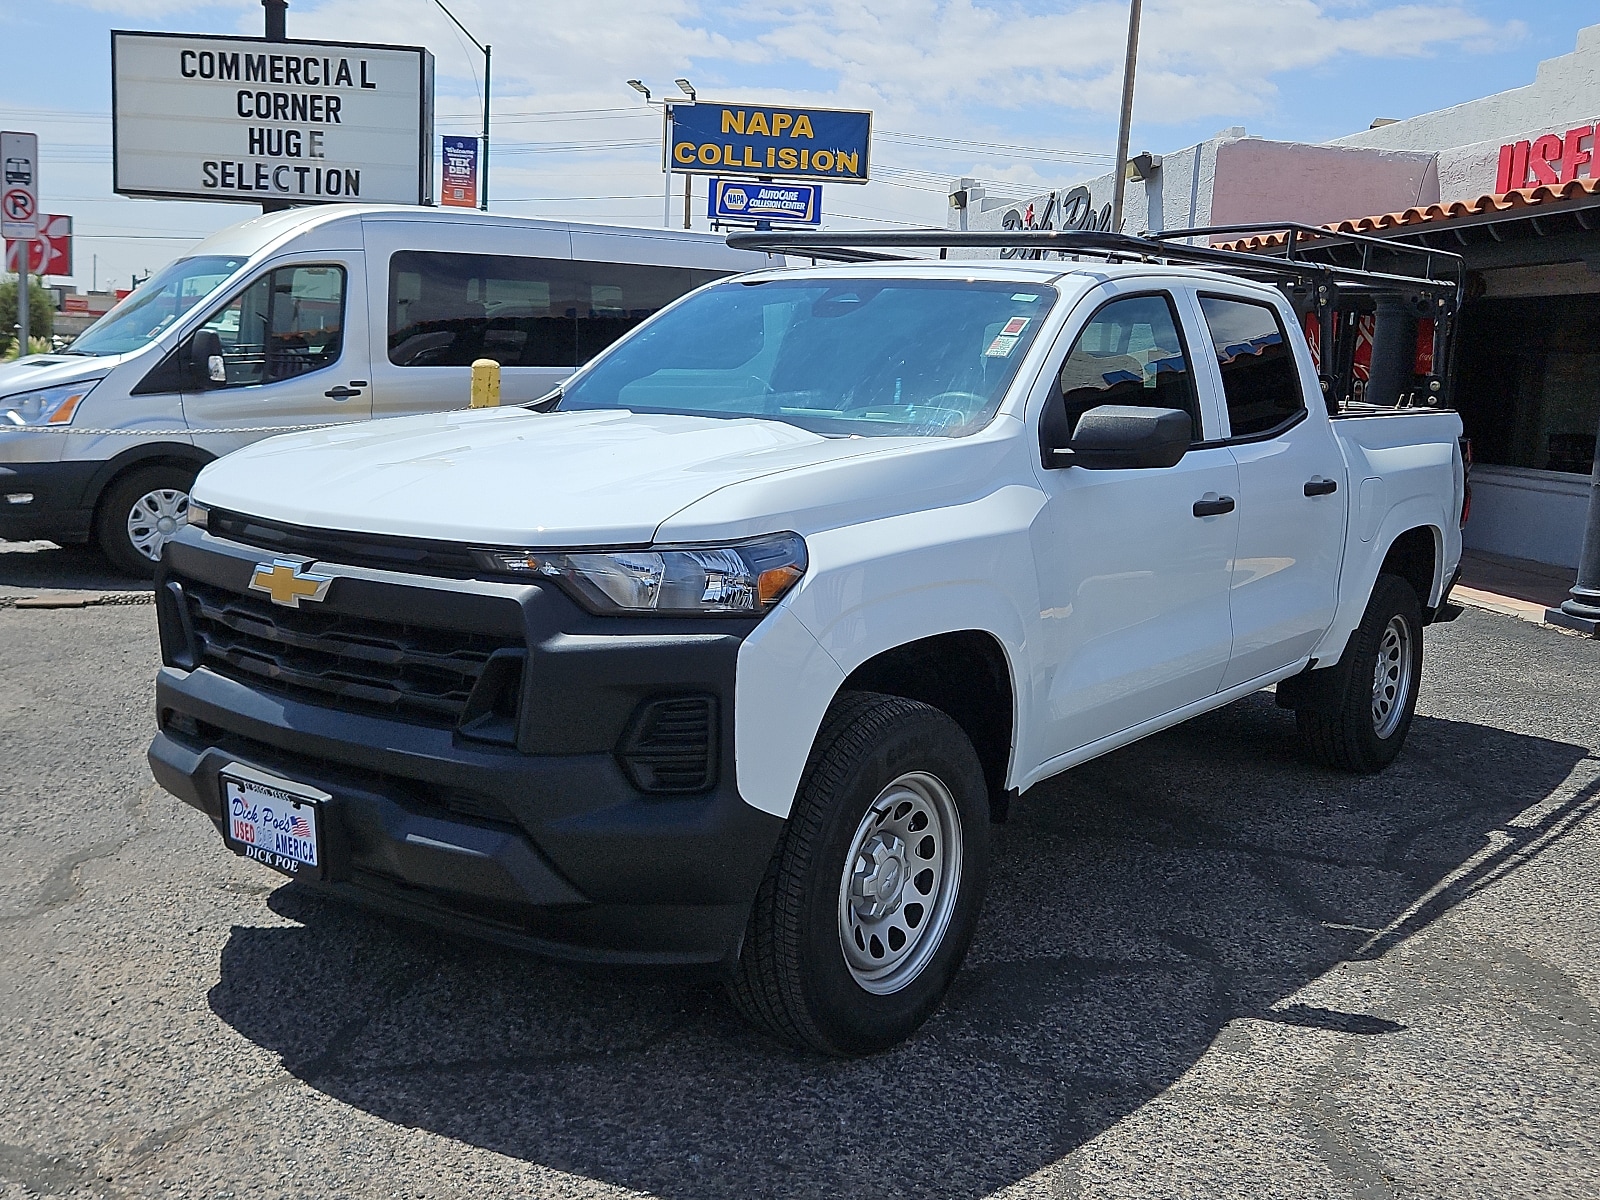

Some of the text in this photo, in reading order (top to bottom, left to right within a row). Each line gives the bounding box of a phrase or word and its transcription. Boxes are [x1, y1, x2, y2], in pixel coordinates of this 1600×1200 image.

[181, 50, 376, 89] COMMERCIAL
[237, 90, 341, 123] CORNER
[721, 110, 814, 139] NAPA
[248, 127, 324, 158] HUGE
[674, 142, 859, 174] COLLISION
[1495, 120, 1600, 194] USE
[202, 161, 360, 197] SELECTION
[727, 193, 745, 205] NAPA
[749, 198, 806, 211] COLLISION CENTER
[232, 797, 291, 834] Dick Poe's
[234, 820, 255, 843] USED
[275, 833, 315, 862] AMERICA
[245, 845, 299, 872] DICK POE
